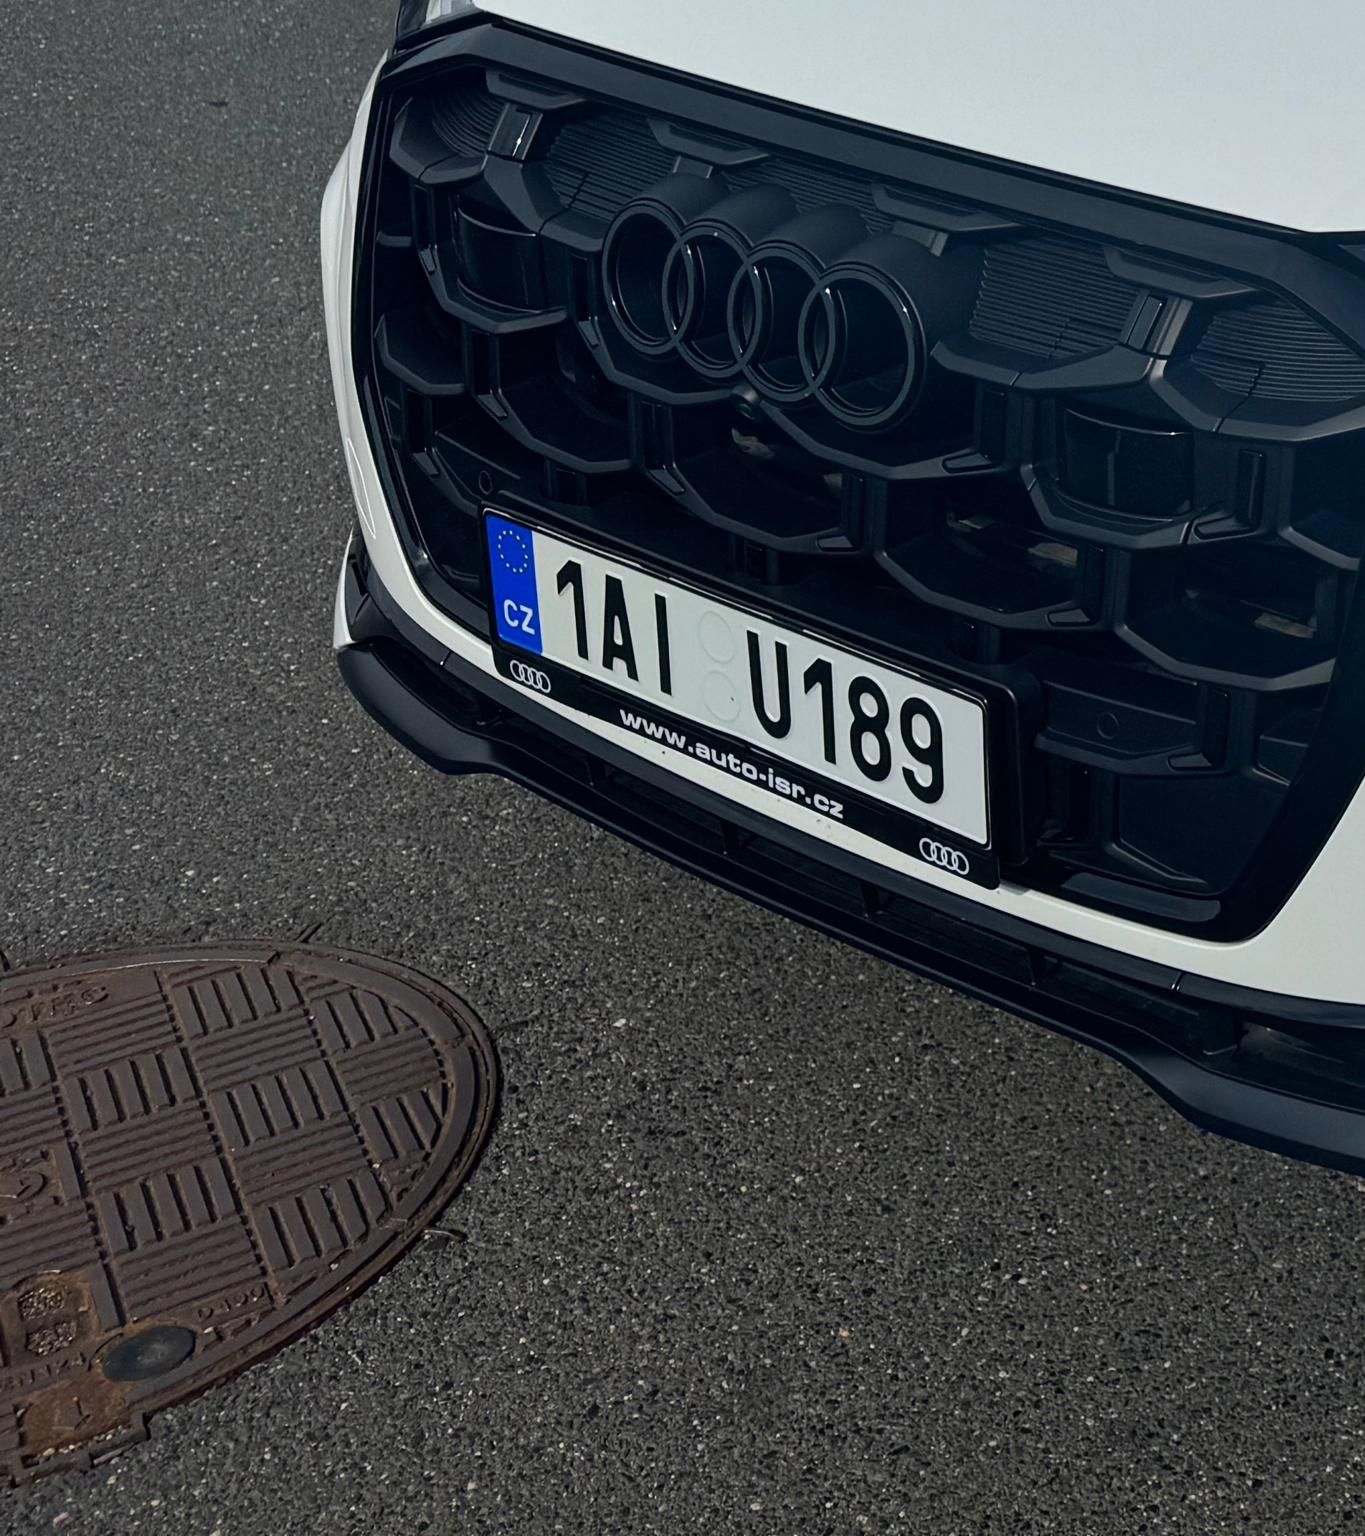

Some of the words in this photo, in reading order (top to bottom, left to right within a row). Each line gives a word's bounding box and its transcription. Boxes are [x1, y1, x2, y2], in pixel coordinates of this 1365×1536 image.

[503, 598, 536, 636] CZ
[556, 559, 673, 697] 1AI
[746, 629, 945, 805] U189
[619, 708, 845, 820] www.auto-isr.cz
